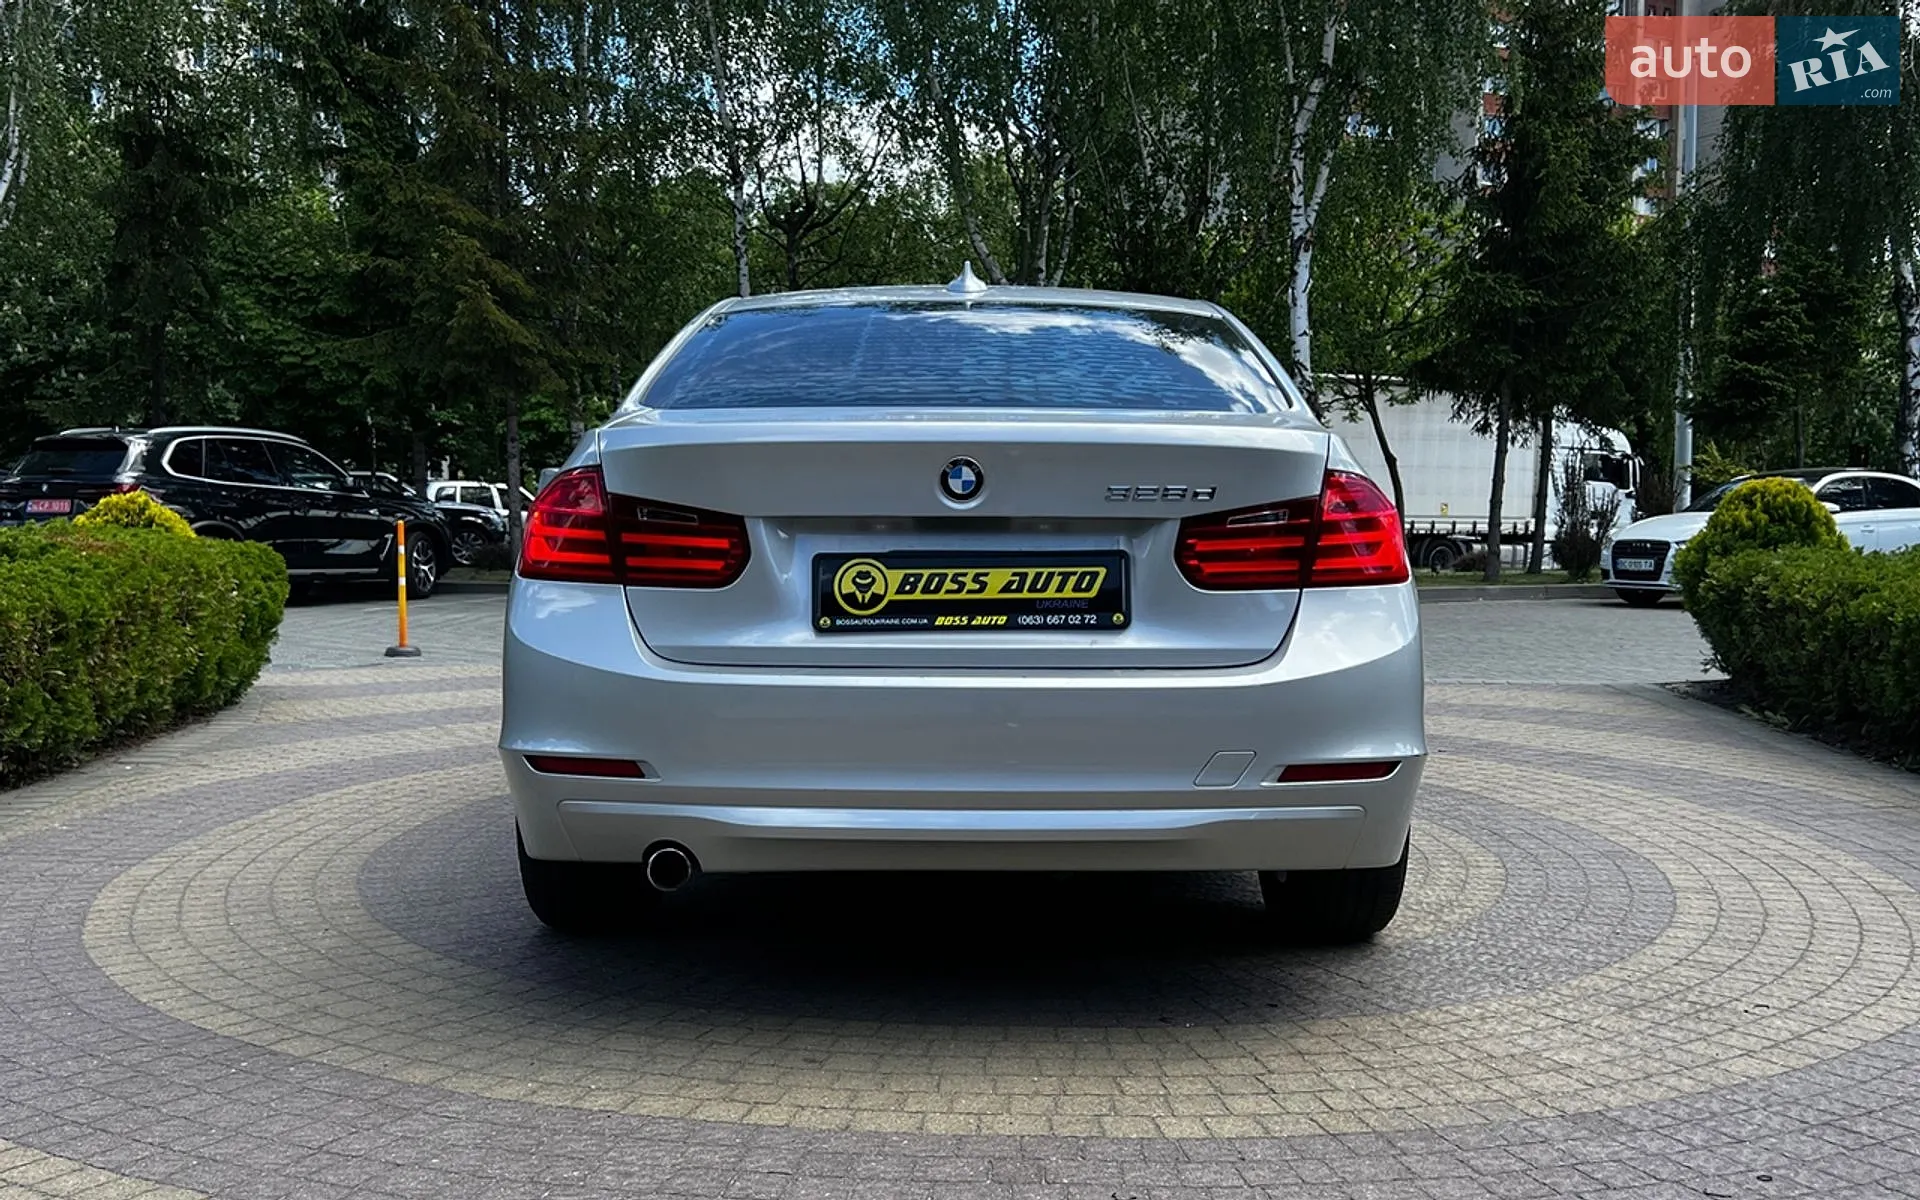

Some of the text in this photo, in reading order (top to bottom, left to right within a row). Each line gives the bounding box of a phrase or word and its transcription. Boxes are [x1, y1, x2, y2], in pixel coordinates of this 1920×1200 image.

[894, 570, 1101, 595] BOSS AUTO
[1036, 599, 1089, 608] UKRAINE
[934, 615, 1008, 626] BOSS AUTO
[1017, 614, 1097, 625] (063) 667 02 72
